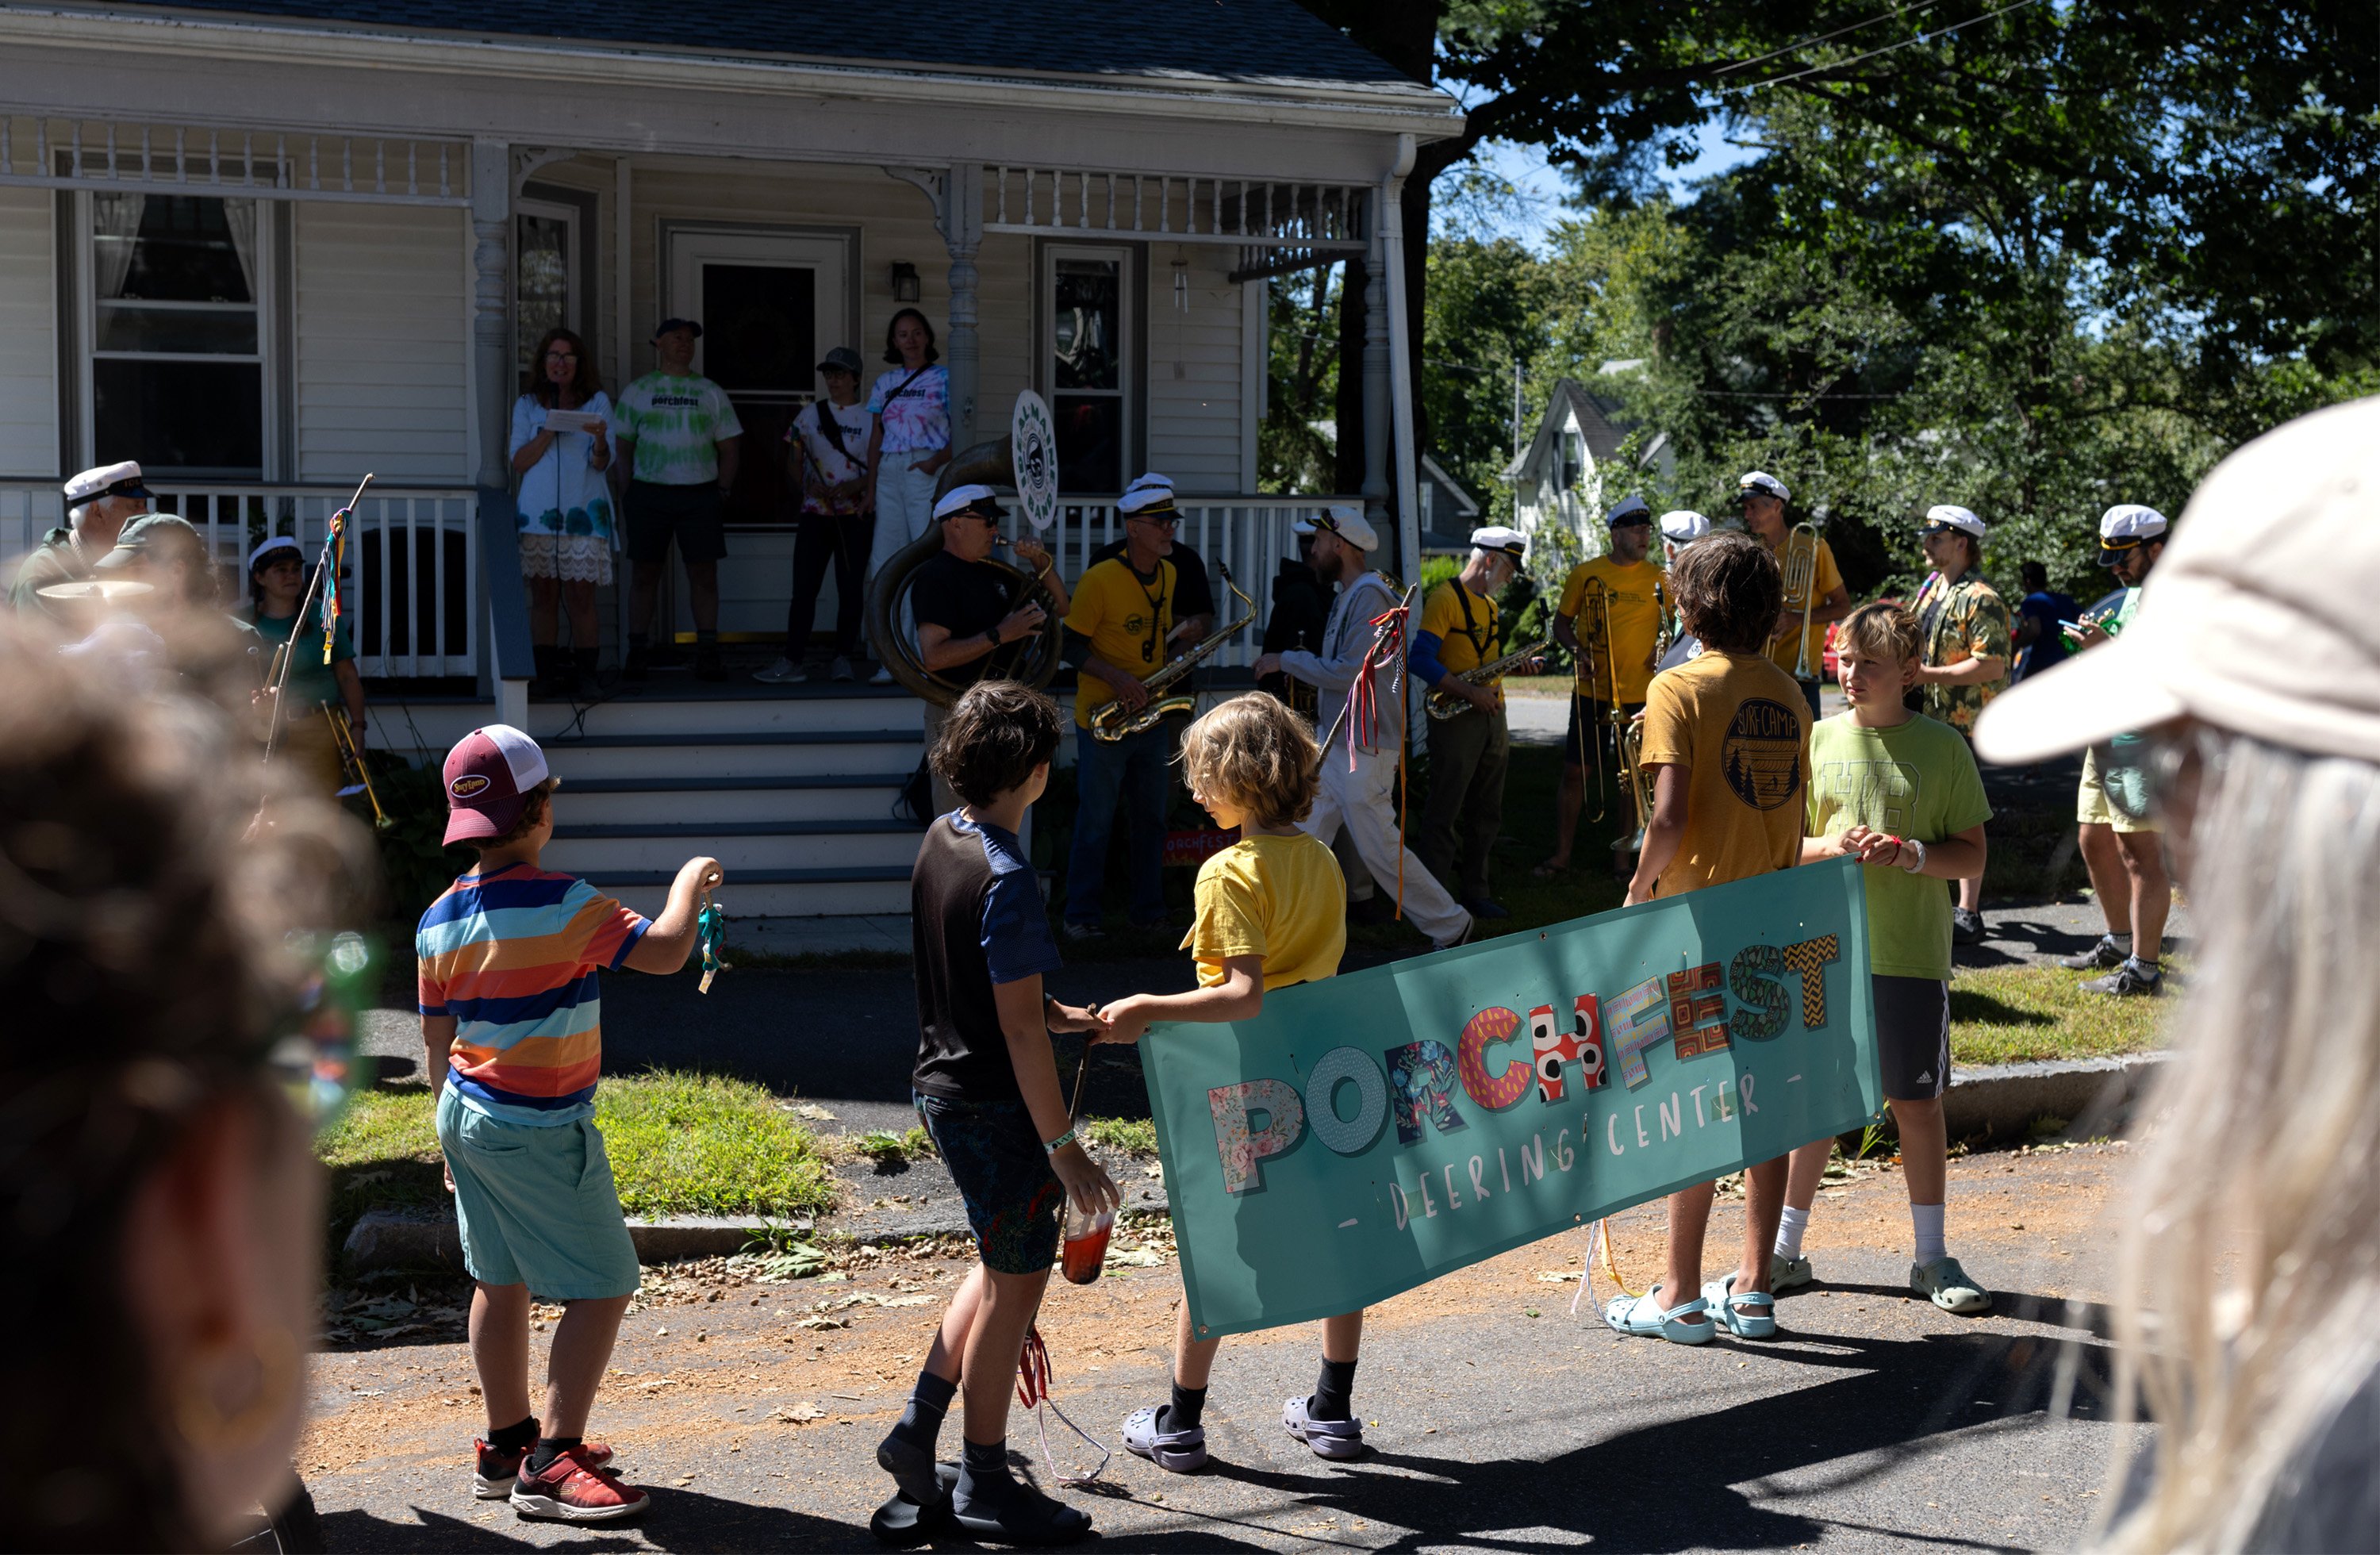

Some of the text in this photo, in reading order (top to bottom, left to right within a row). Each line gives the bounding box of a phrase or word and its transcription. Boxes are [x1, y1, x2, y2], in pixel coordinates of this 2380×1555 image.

[1027, 492, 1053, 520] BAND
[1738, 705, 1798, 737] SURF CAMP
[1822, 761, 1921, 843] HB
[1207, 933, 1838, 1193] PORCHFEST
[1390, 1073, 1759, 1231] DEERING CENTER
